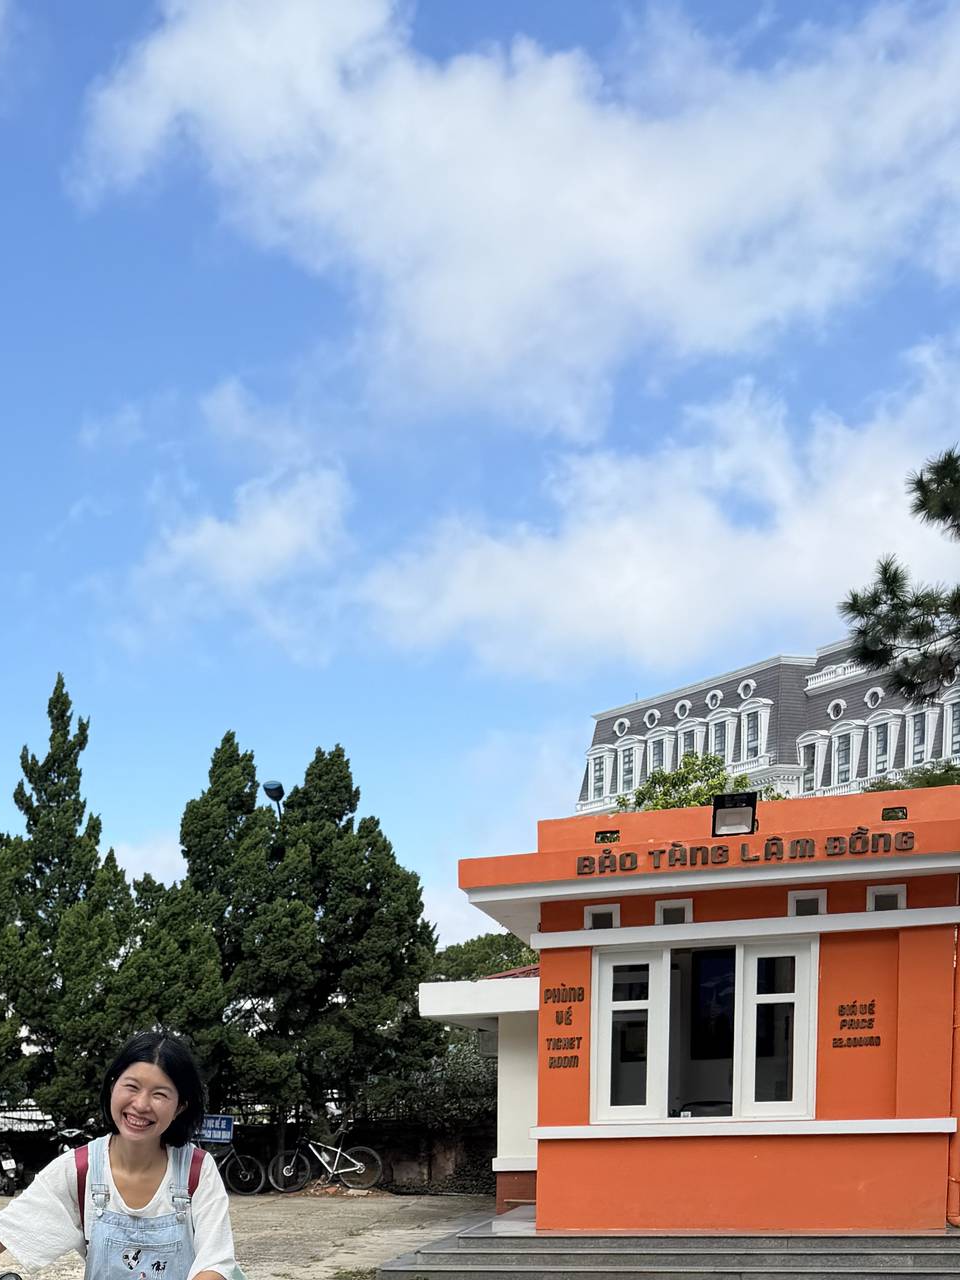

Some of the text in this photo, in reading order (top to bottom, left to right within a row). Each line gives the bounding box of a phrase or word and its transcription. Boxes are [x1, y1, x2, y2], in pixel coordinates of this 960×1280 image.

[576, 826, 915, 875] BẢO TÀNG LÂM ĐỒNG
[546, 1036, 583, 1051] TICKET
[548, 1055, 580, 1069] ROOM
